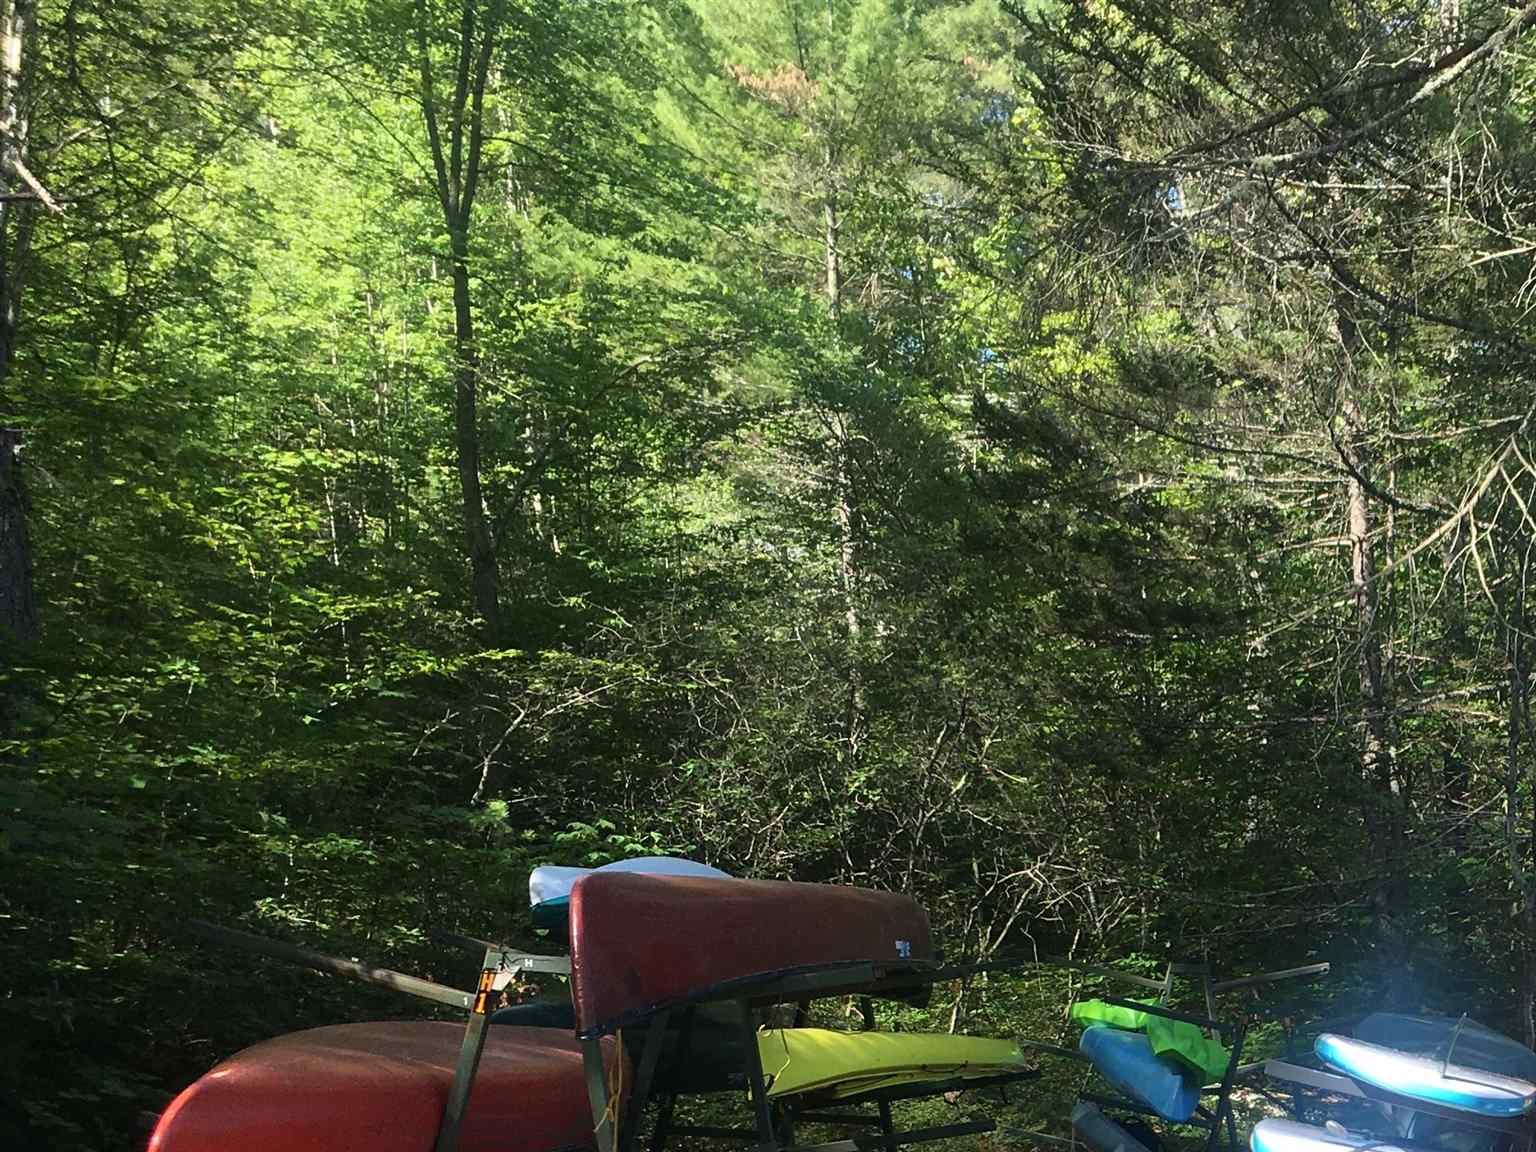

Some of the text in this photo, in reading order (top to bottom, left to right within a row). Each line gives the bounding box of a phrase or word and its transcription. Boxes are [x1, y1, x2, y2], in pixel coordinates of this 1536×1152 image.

[524, 958, 533, 968] H
[480, 970, 496, 992] H
[474, 992, 487, 1014] 1
